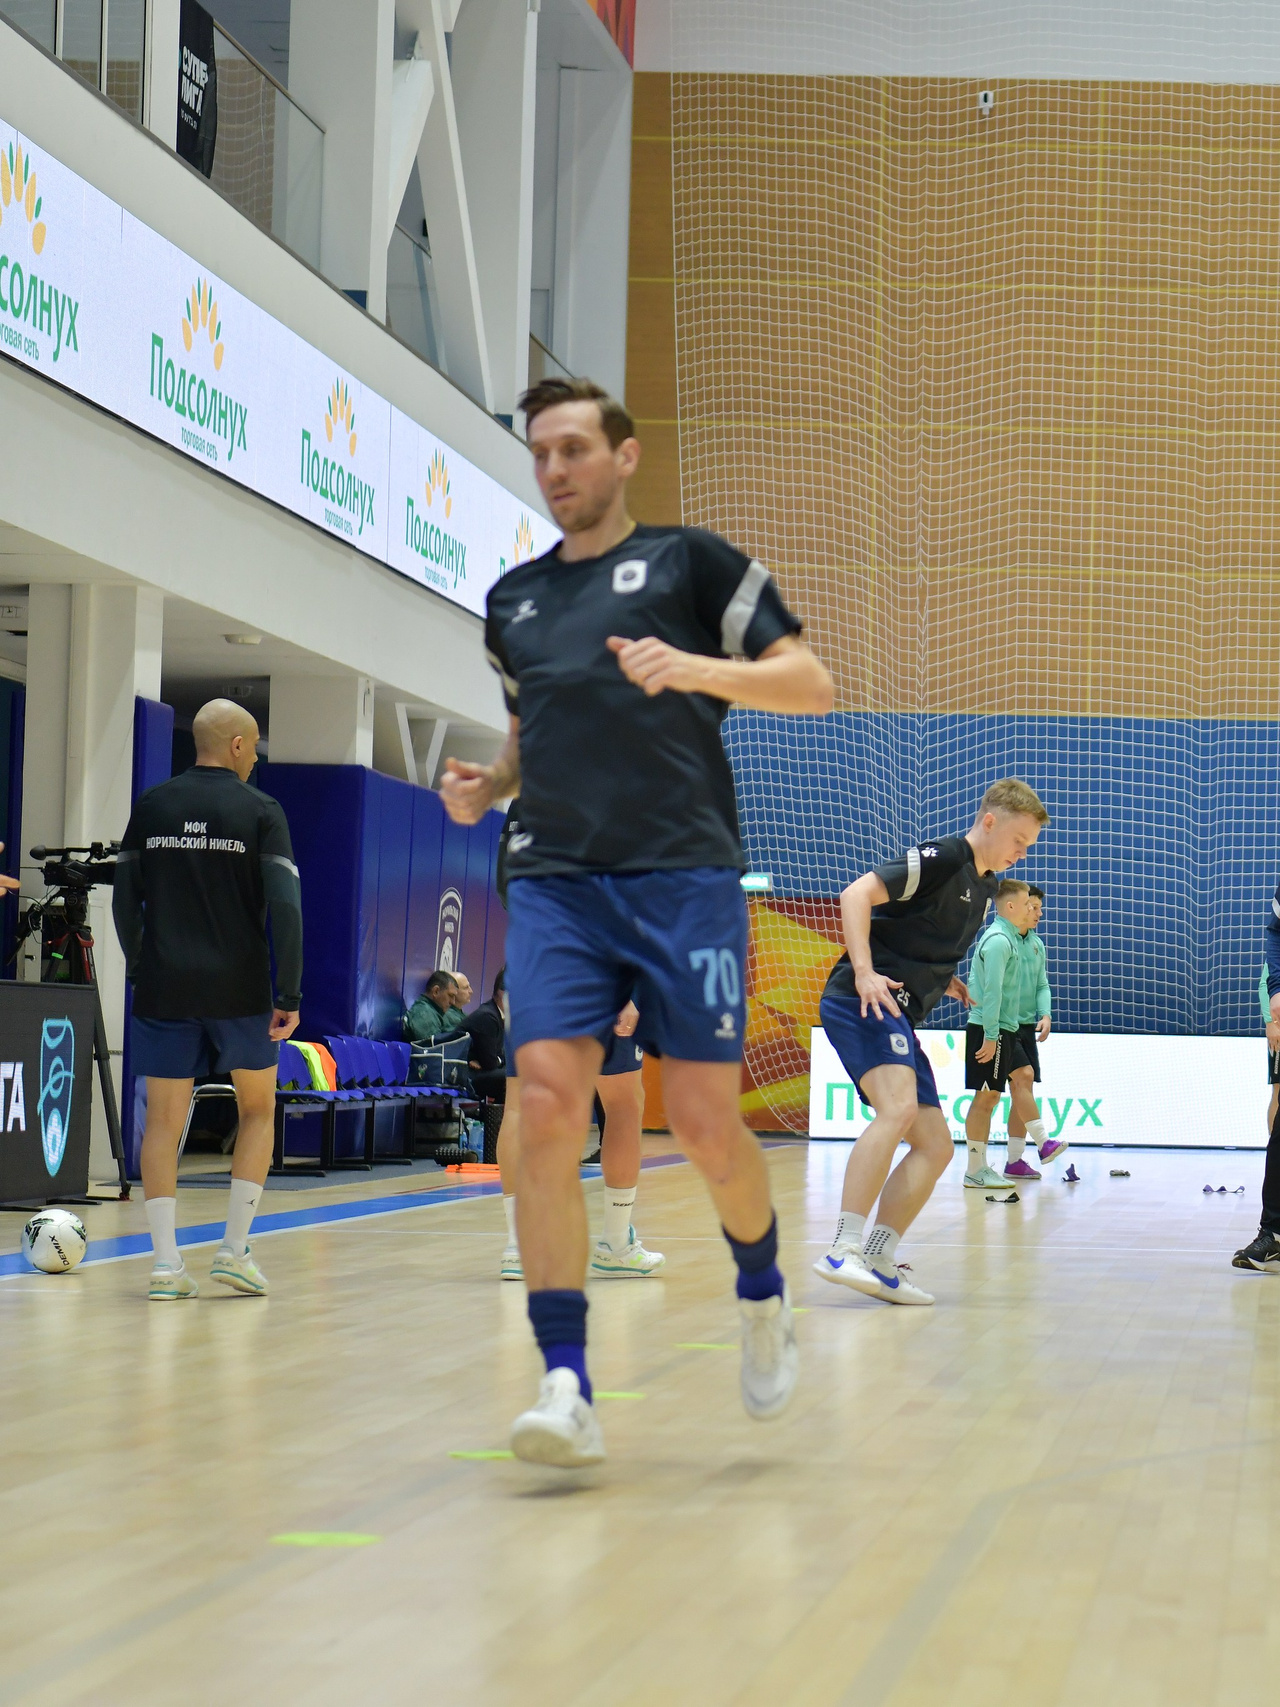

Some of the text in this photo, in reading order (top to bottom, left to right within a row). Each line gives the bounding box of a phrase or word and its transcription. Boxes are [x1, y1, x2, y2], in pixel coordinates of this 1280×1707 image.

[0, 321, 22, 351] говая
[150, 332, 248, 461] Подсолнух
[181, 426, 218, 461] торговая сеть
[300, 428, 375, 536] Подсолнух
[324, 507, 353, 536] торговая сеть
[405, 495, 467, 589] Подсолнух
[184, 821, 207, 834] МФК
[146, 835, 246, 853] НОРИЛЬСКИЙ НИКЕЛЬ
[688, 947, 740, 1008] 70
[897, 987, 911, 1007] 25
[49, 1235, 70, 1266] DEMIX
